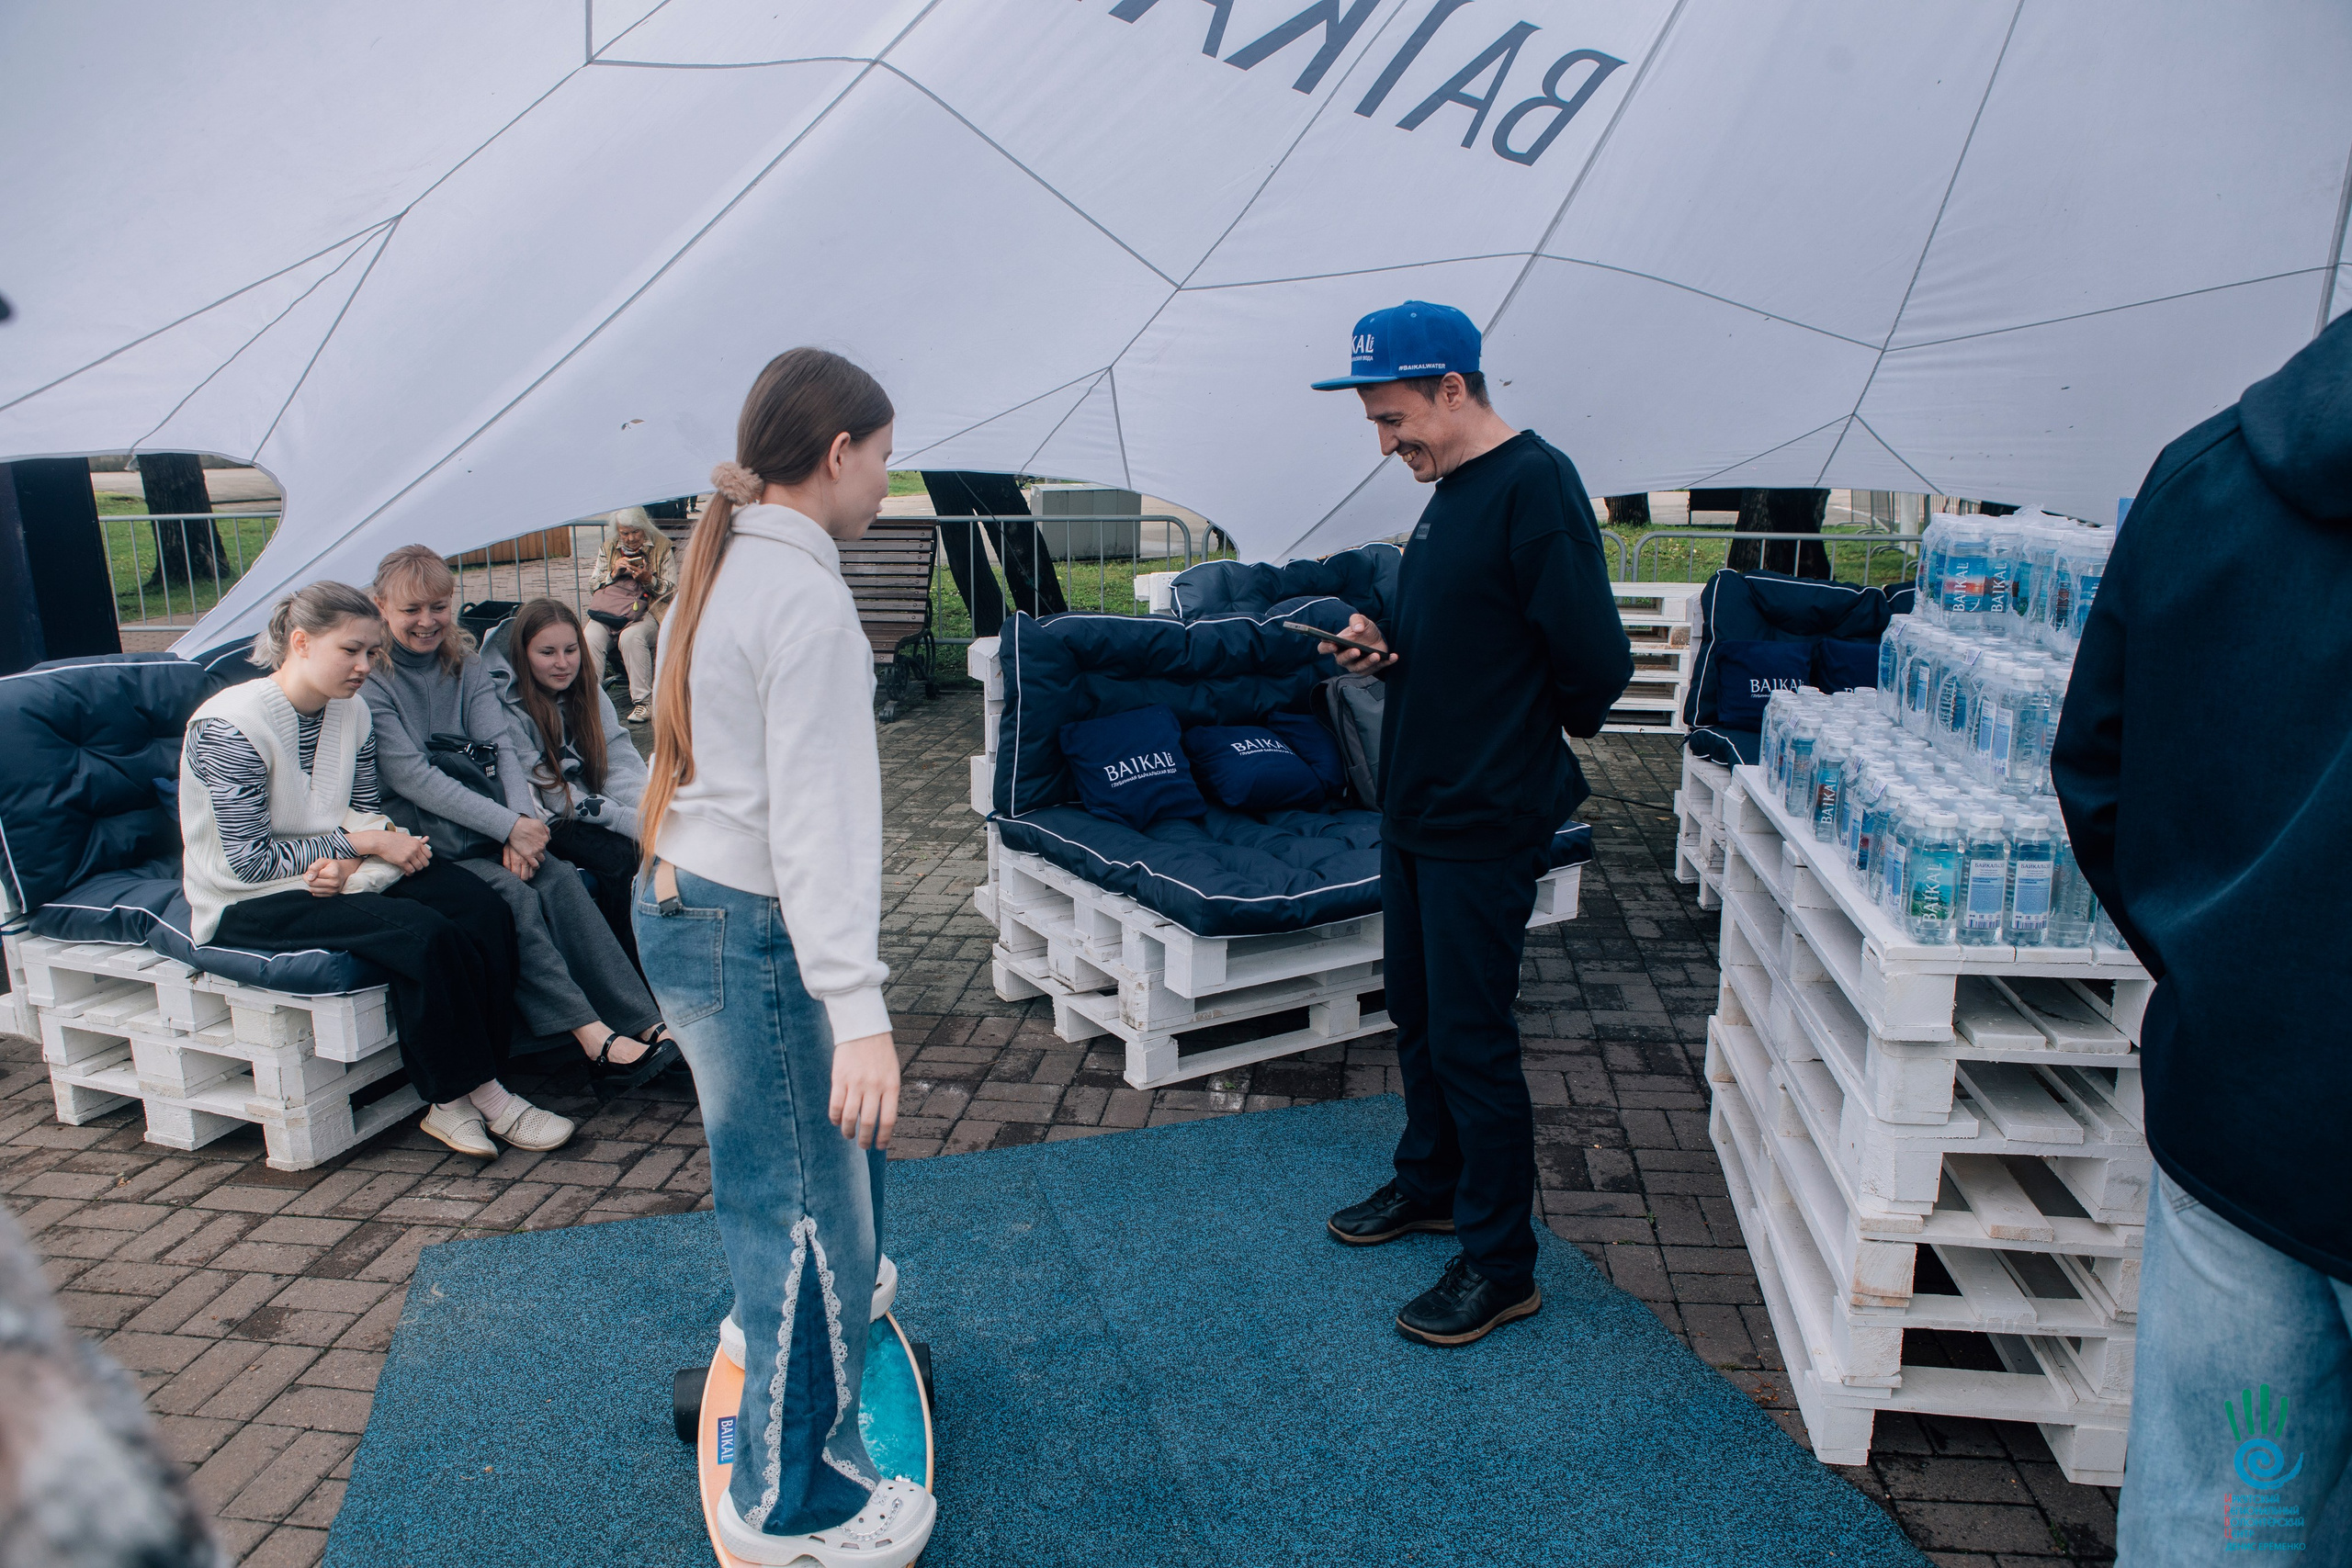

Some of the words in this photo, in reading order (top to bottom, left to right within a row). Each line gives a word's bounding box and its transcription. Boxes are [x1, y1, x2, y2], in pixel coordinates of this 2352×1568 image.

[1398, 363, 1446, 371] #BAIKALWATER
[1952, 562, 1969, 613] BAIKAL
[1991, 562, 2007, 613] BAIKAL
[1111, 775, 1137, 787] ГЛУБИННАЯ
[1137, 771, 1167, 779] БАЙКАЛЬСКАЯ
[1820, 774, 1838, 824] BAIKAL
[1923, 863, 1942, 922] BAIKAL
[721, 1419, 733, 1461] BAIKAL
